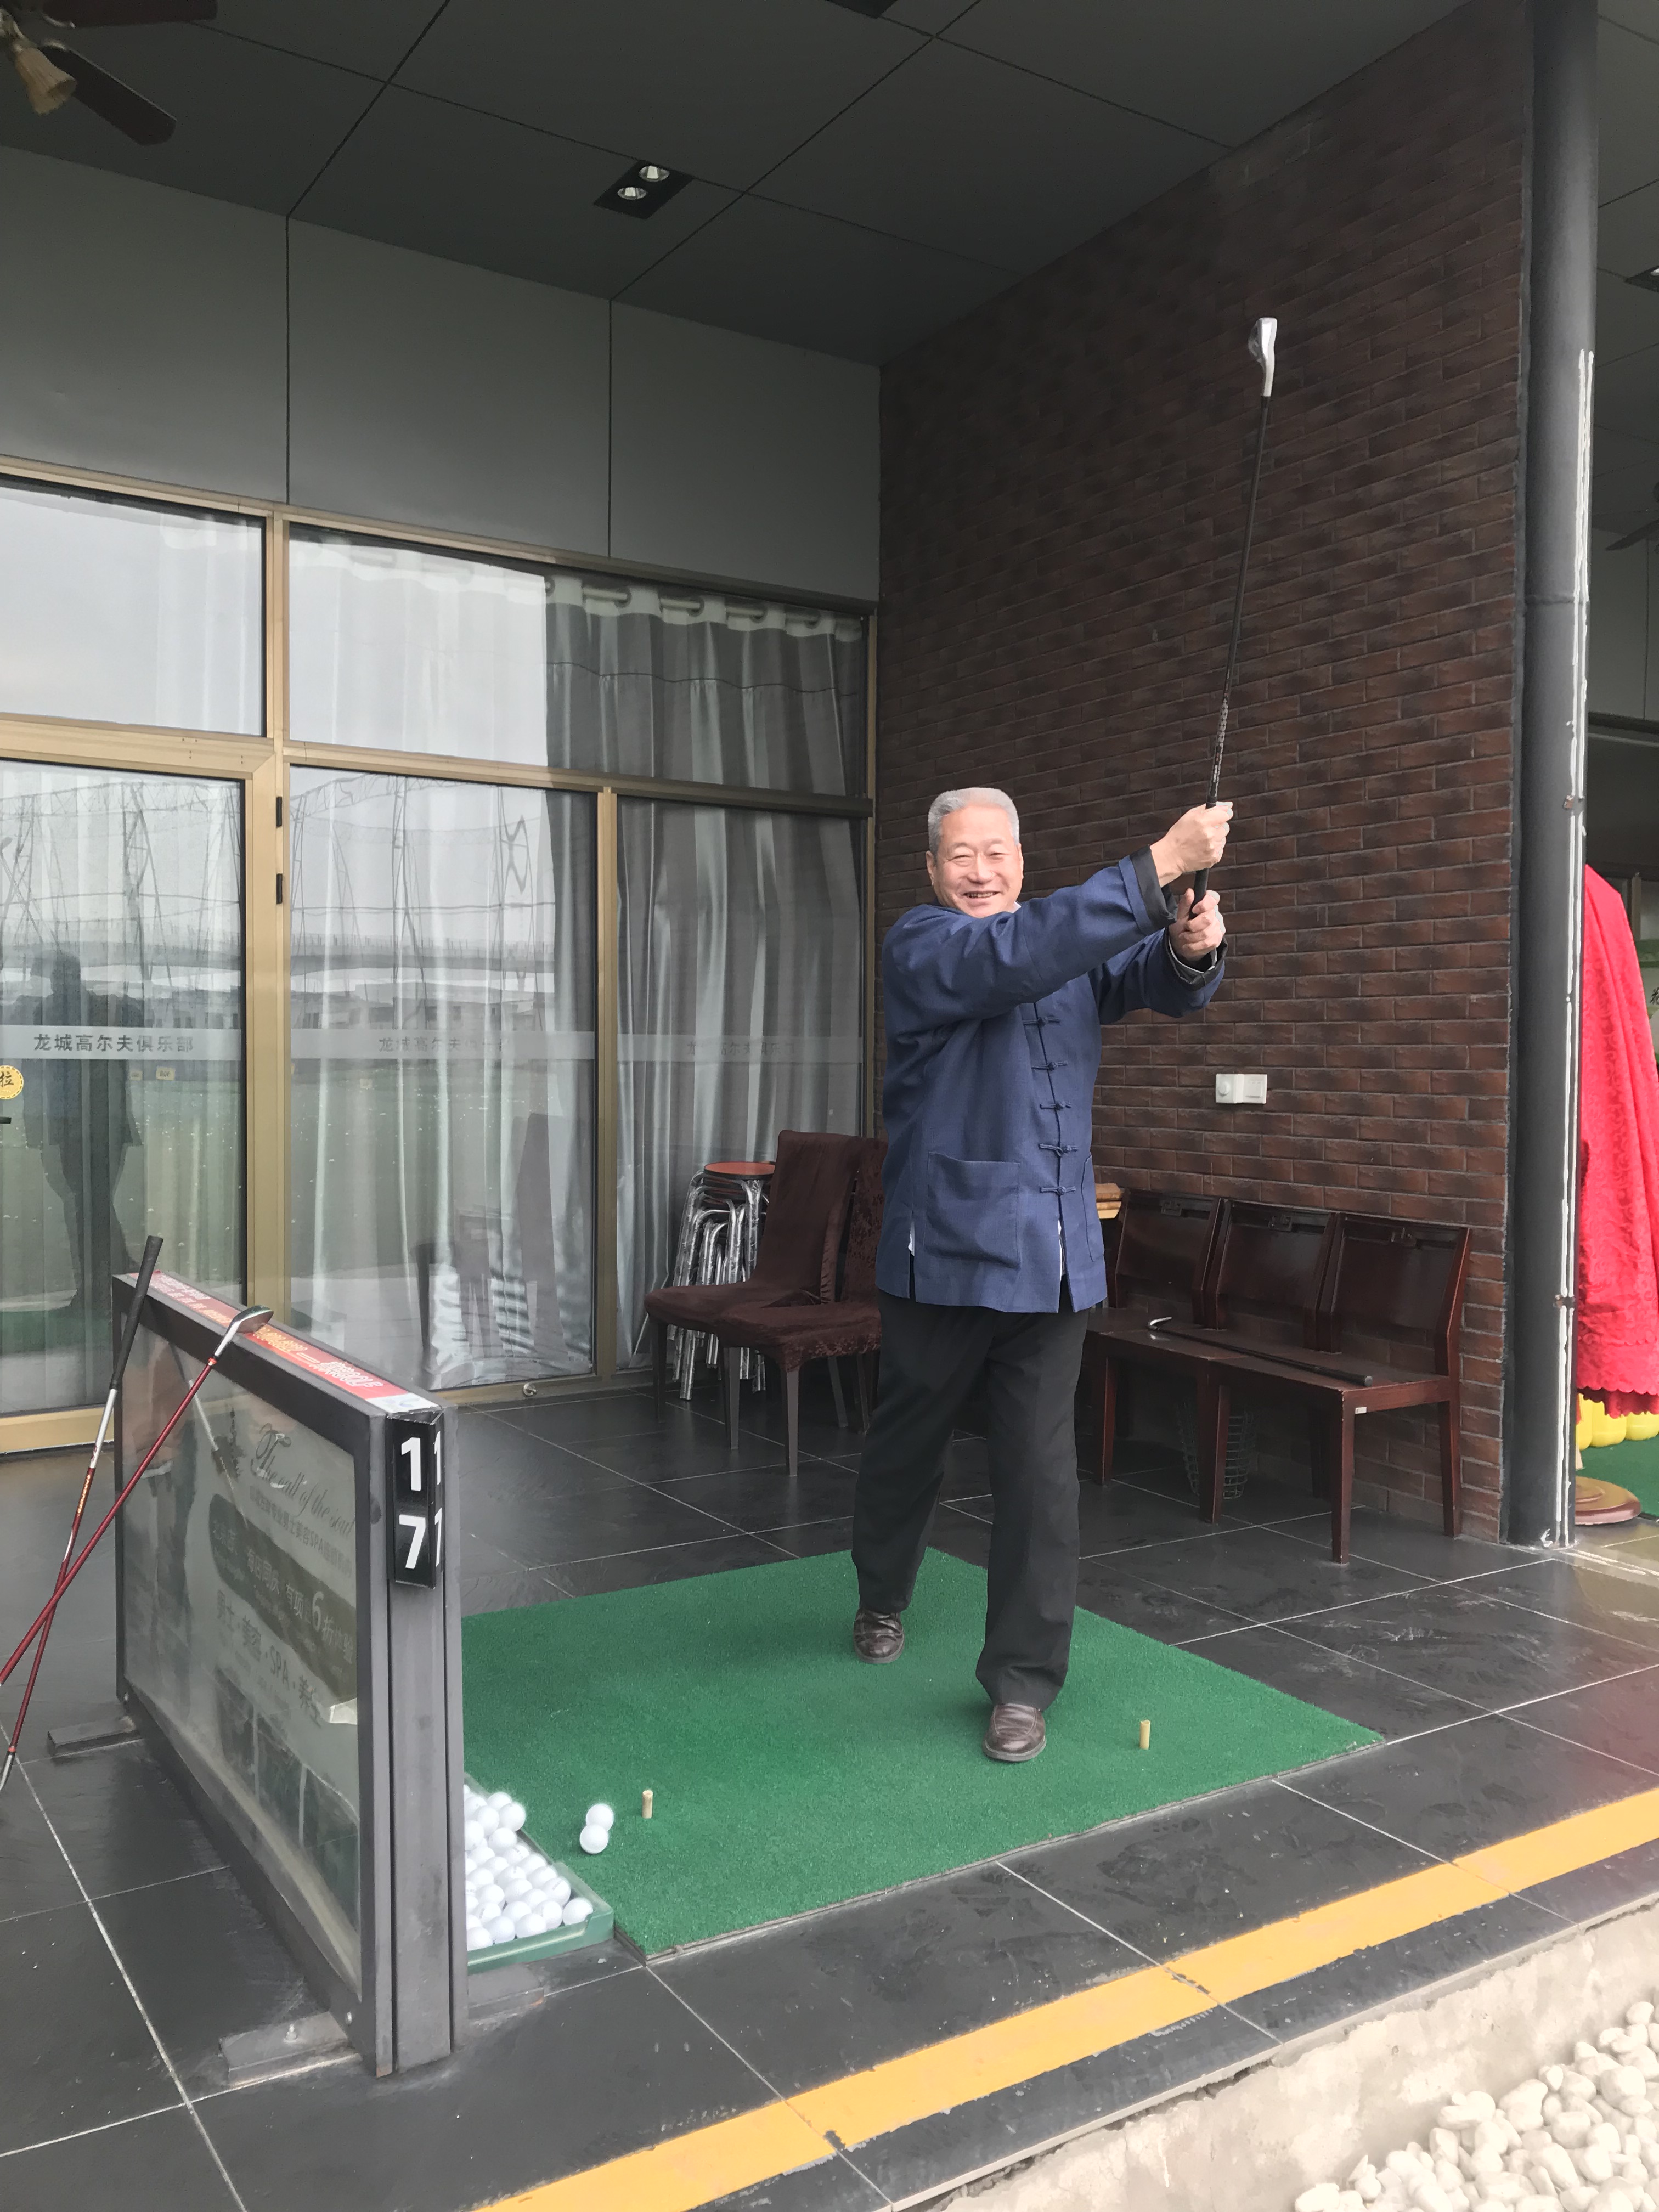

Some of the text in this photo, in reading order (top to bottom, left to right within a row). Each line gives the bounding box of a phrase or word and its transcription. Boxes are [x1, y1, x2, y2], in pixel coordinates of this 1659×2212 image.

[33, 1033, 193, 1053] 龙城高尔夫俱乐部
